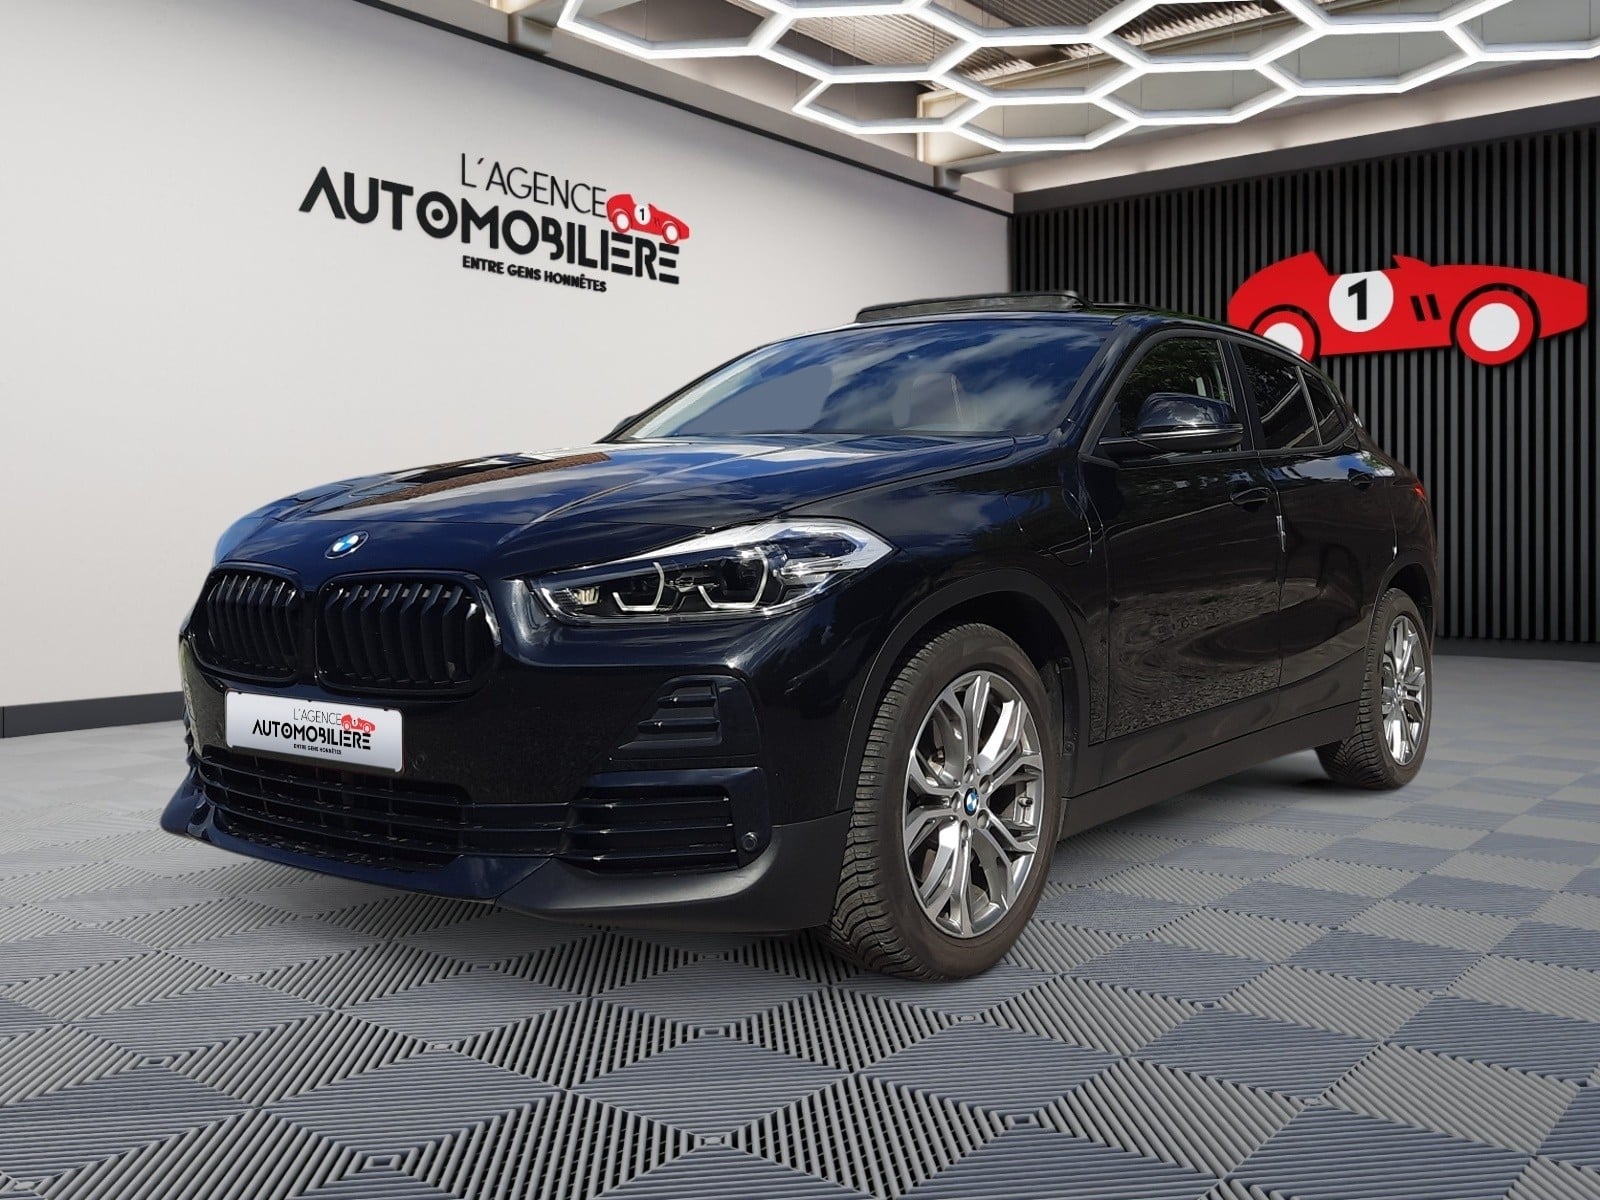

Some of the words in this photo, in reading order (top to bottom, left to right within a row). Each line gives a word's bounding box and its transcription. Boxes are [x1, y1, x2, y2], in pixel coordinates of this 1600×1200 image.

[638, 207, 646, 221] 1
[462, 255, 504, 275] ENTRE
[509, 264, 541, 281] GENS
[544, 270, 607, 292] HONNÊTES
[1347, 278, 1368, 321] 1
